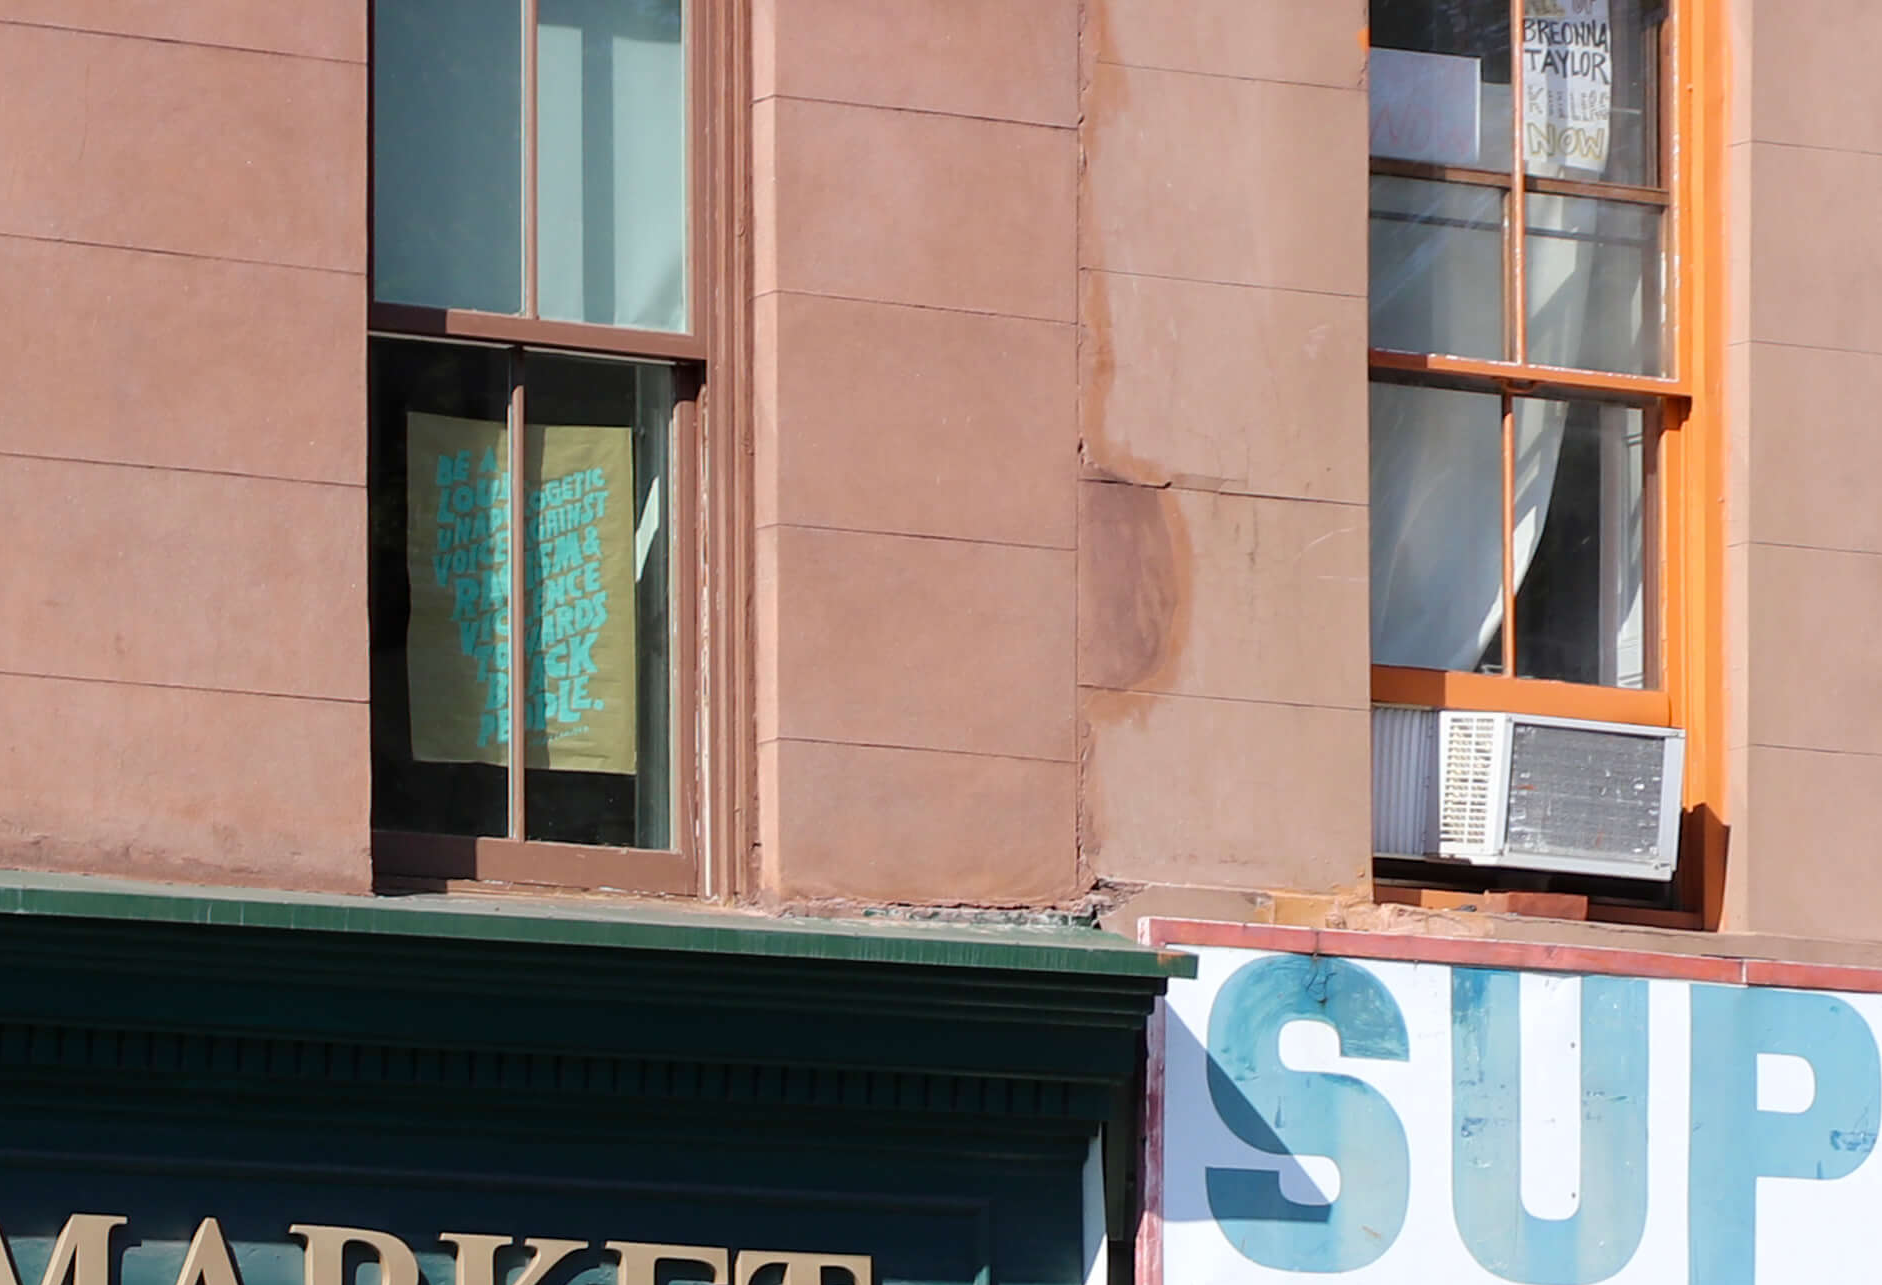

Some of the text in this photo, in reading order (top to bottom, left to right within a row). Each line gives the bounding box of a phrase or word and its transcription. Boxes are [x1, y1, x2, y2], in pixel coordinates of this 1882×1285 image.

[1524, 18, 1609, 53] BREONNA
[1524, 48, 1611, 85] TAYLOR
[1526, 122, 1606, 161] NOW
[436, 444, 499, 487] BE A
